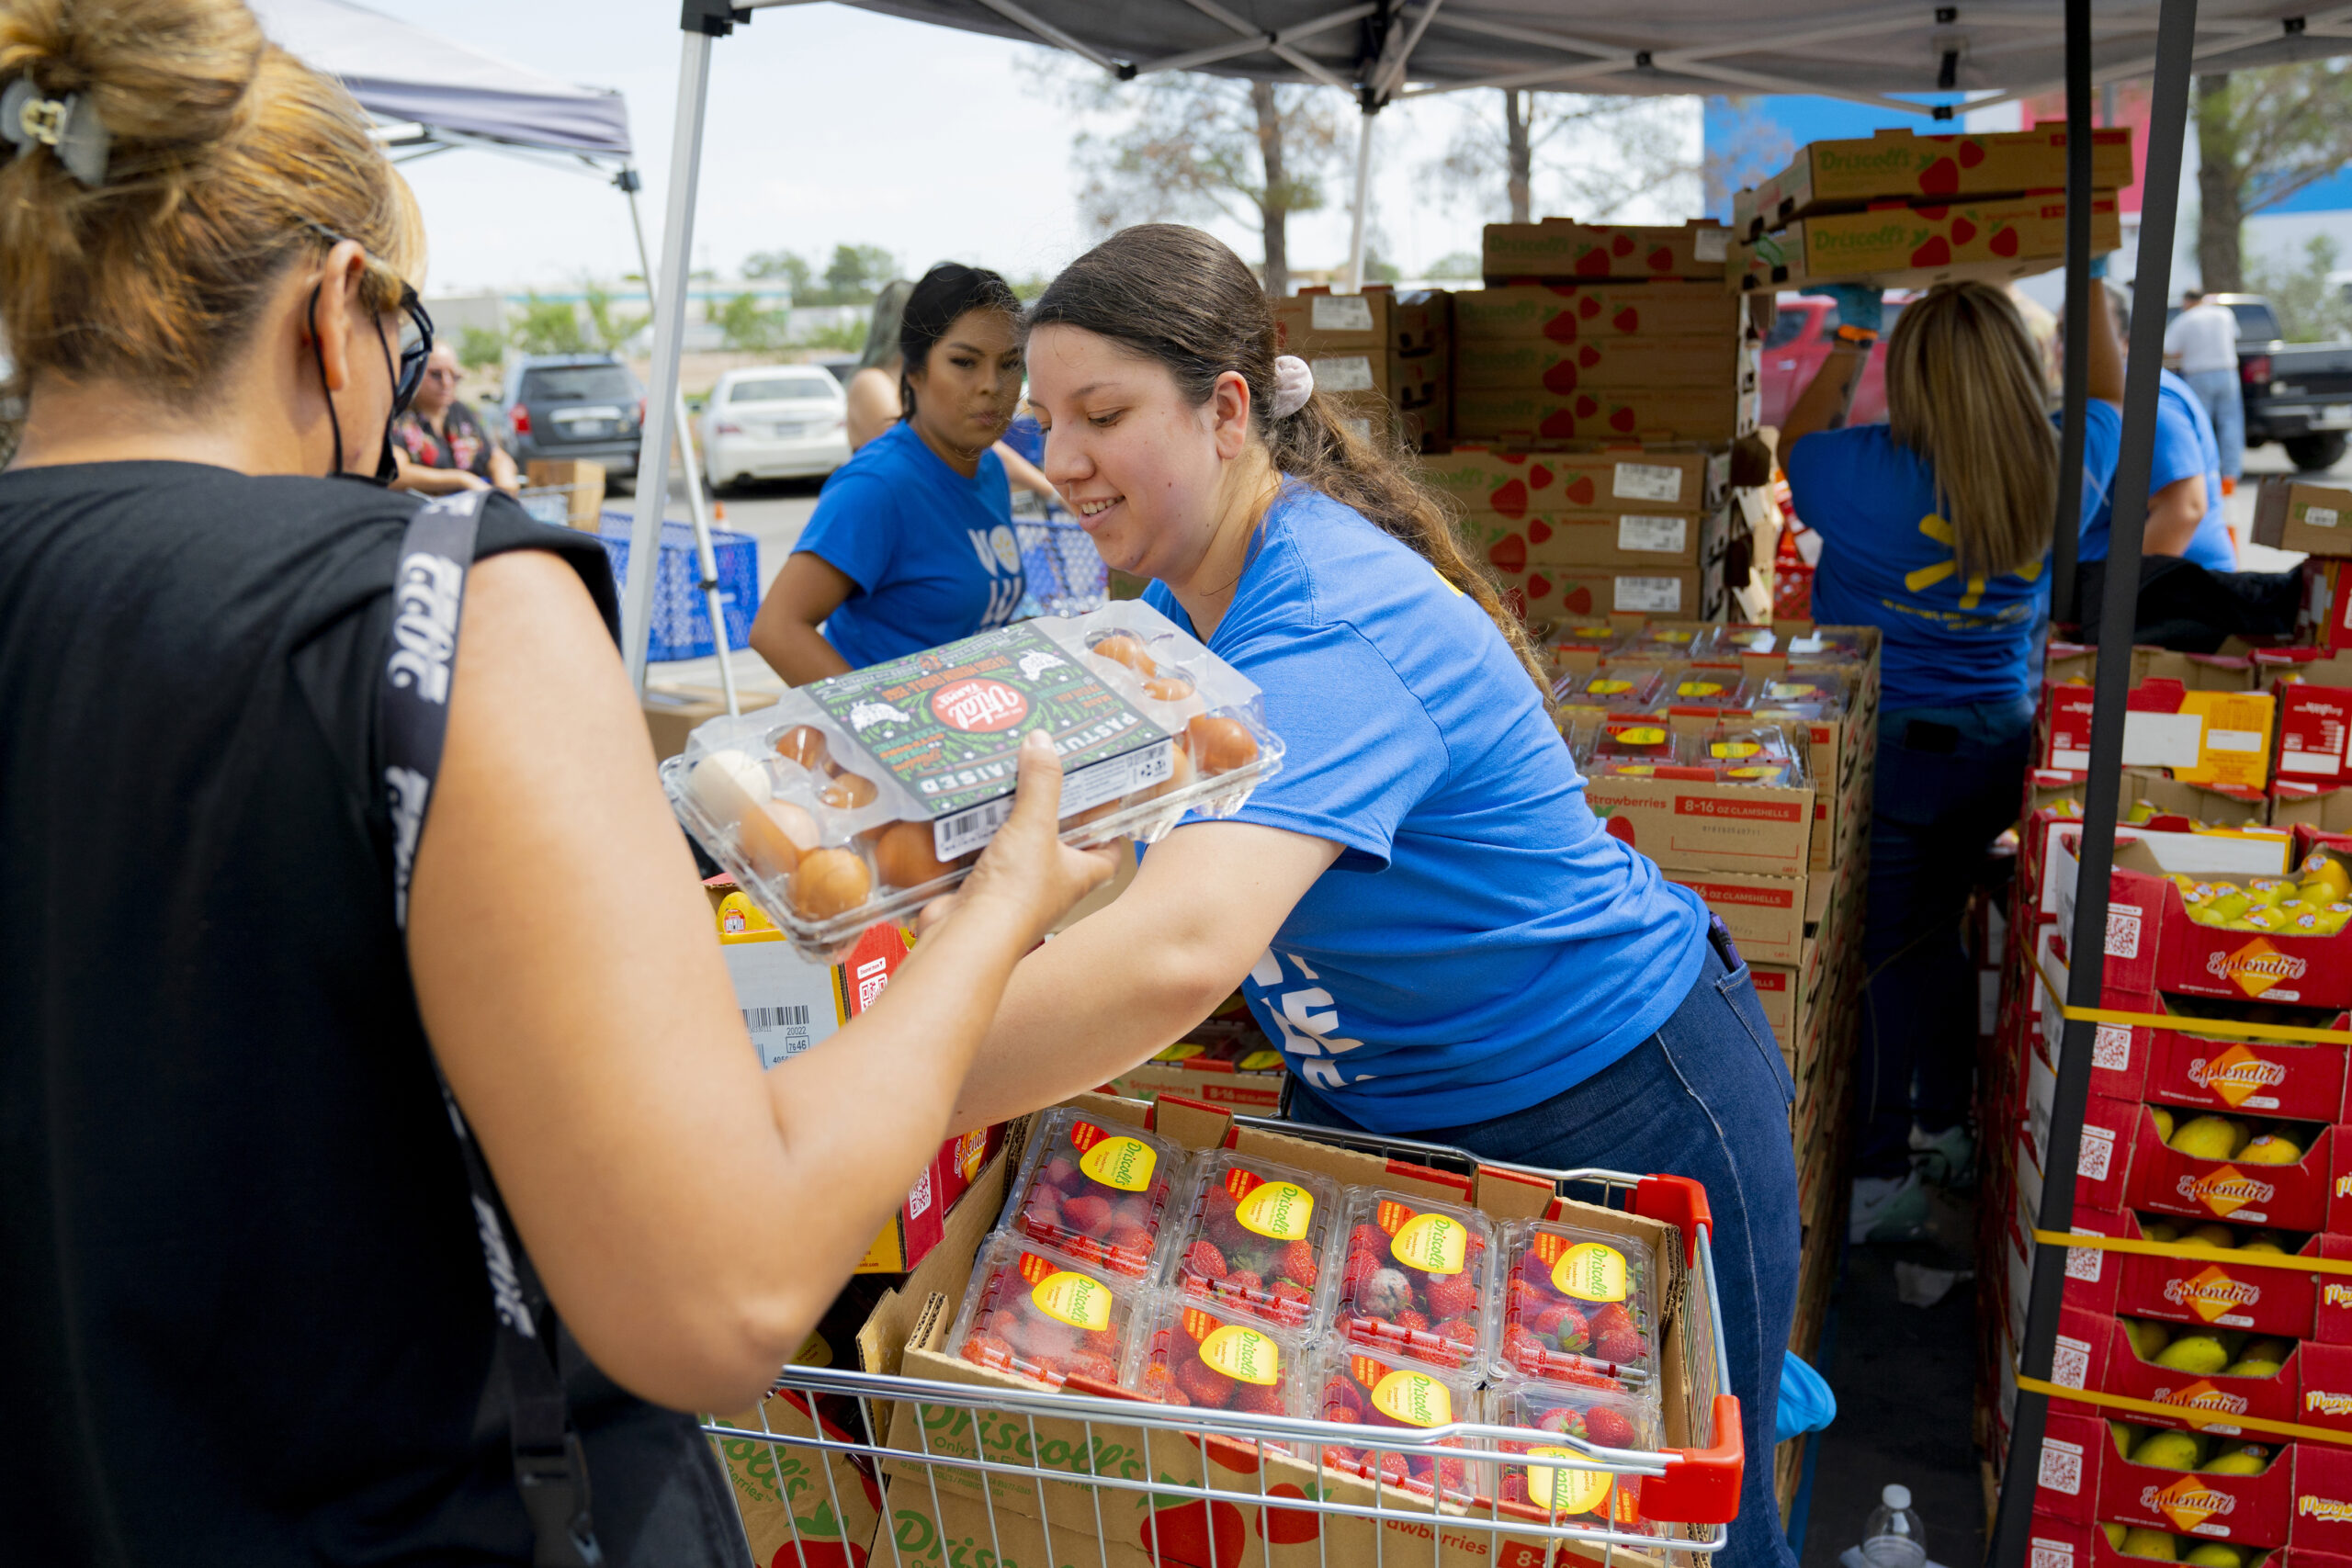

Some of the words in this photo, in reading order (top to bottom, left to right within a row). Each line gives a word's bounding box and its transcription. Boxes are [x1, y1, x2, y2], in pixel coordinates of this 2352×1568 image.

[945, 685, 1022, 729] Vital
[1057, 711, 1138, 756] PASTUR
[1585, 793, 1667, 809] Strawberries
[1684, 800, 1714, 813] 8-16
[1717, 807, 1728, 815] OZ
[1730, 807, 1789, 818] CLAMSHELLS
[1723, 892, 1781, 904] CLAMSHELLS
[2206, 951, 2307, 980] Splendid
[787, 1027, 806, 1035] 20022
[2188, 1057, 2286, 1089] Splendid
[1210, 1088, 1235, 1101] 8-16
[1115, 1142, 1142, 1185] Driscoll's
[2176, 1174, 2275, 1202] Splendid
[1272, 1187, 1298, 1234] Driscoll's
[1429, 1219, 1450, 1269] Driscoll's
[1591, 1248, 1608, 1297] Driscoll's
[1071, 1279, 1095, 1323] Driscoll's
[2164, 1278, 2261, 1306] Splendid
[1240, 1332, 1260, 1379] Driscoll's
[1414, 1376, 1432, 1424] Driscoll's
[912, 1404, 1140, 1480] Driscoll's
[934, 1436, 969, 1459] Only
[2140, 1485, 2236, 1515] Splendid
